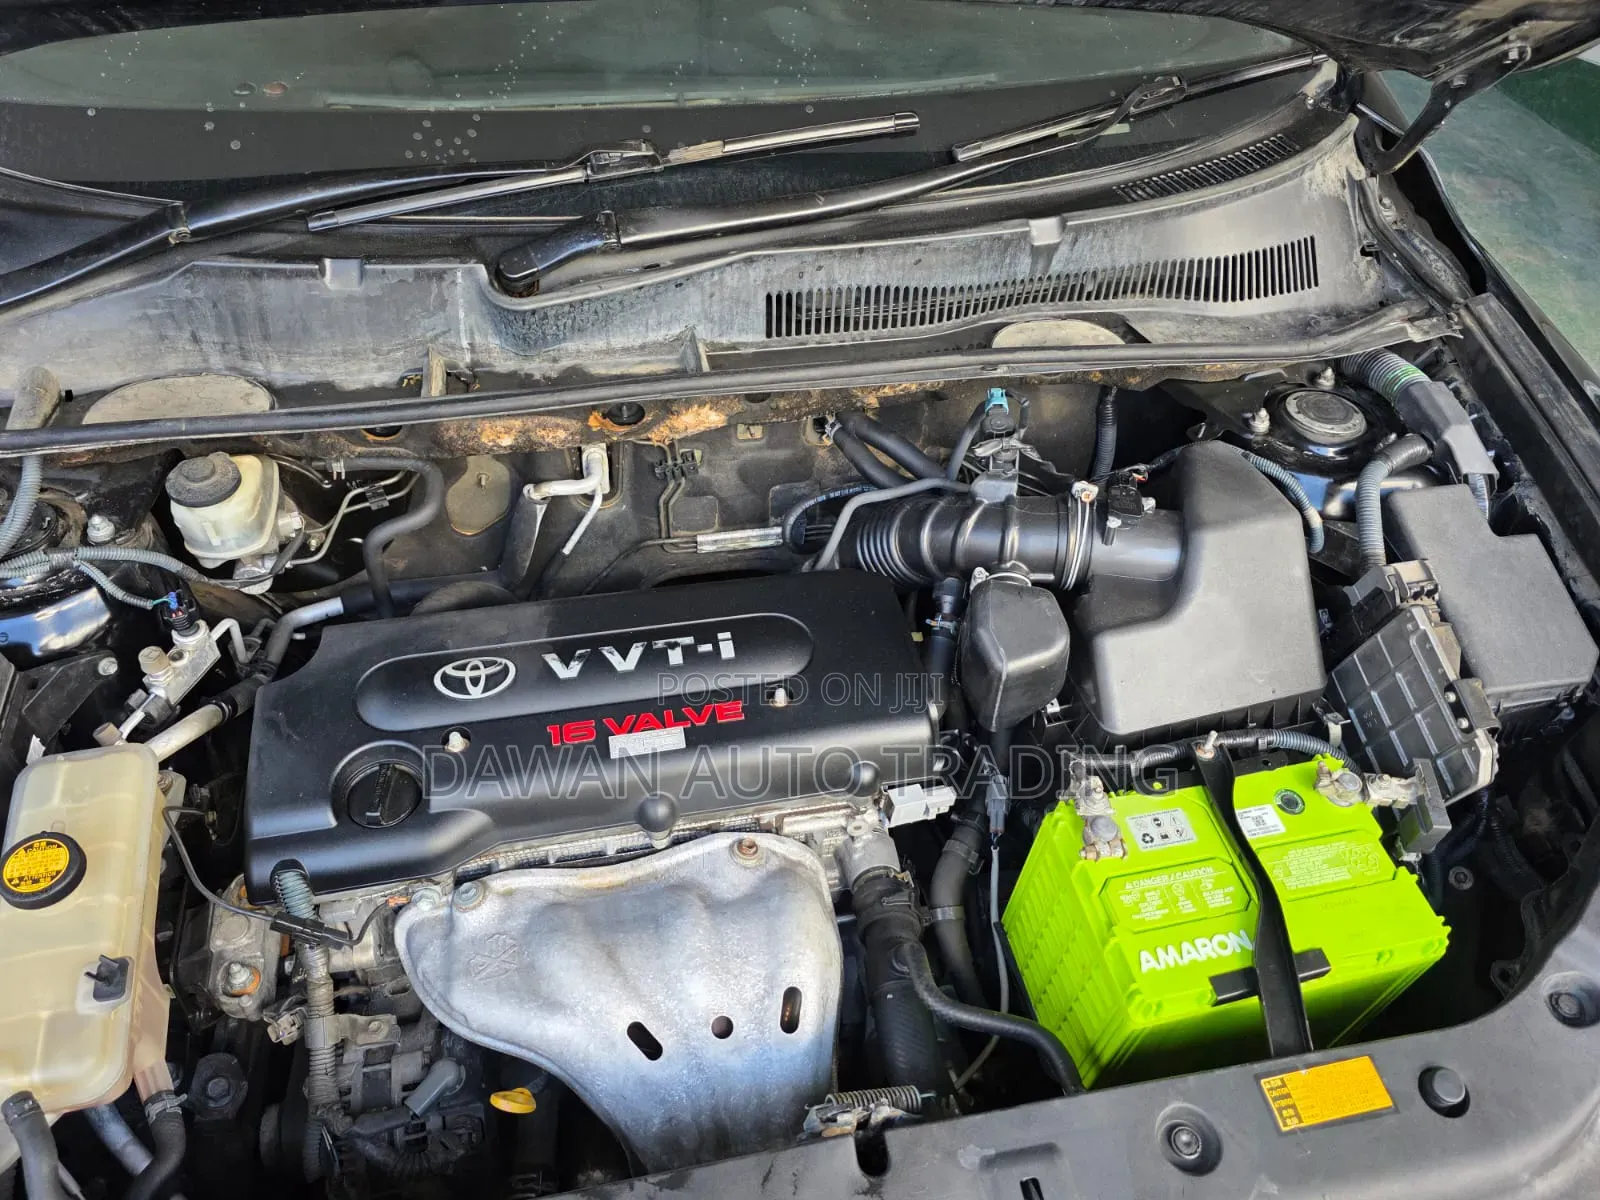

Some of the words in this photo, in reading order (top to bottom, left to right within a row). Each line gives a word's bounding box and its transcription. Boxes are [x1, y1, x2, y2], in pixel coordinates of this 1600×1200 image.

[541, 631, 736, 679] VVT-i
[546, 719, 597, 746] 16
[602, 700, 745, 736] VALVE
[1139, 929, 1254, 974] AMARON
